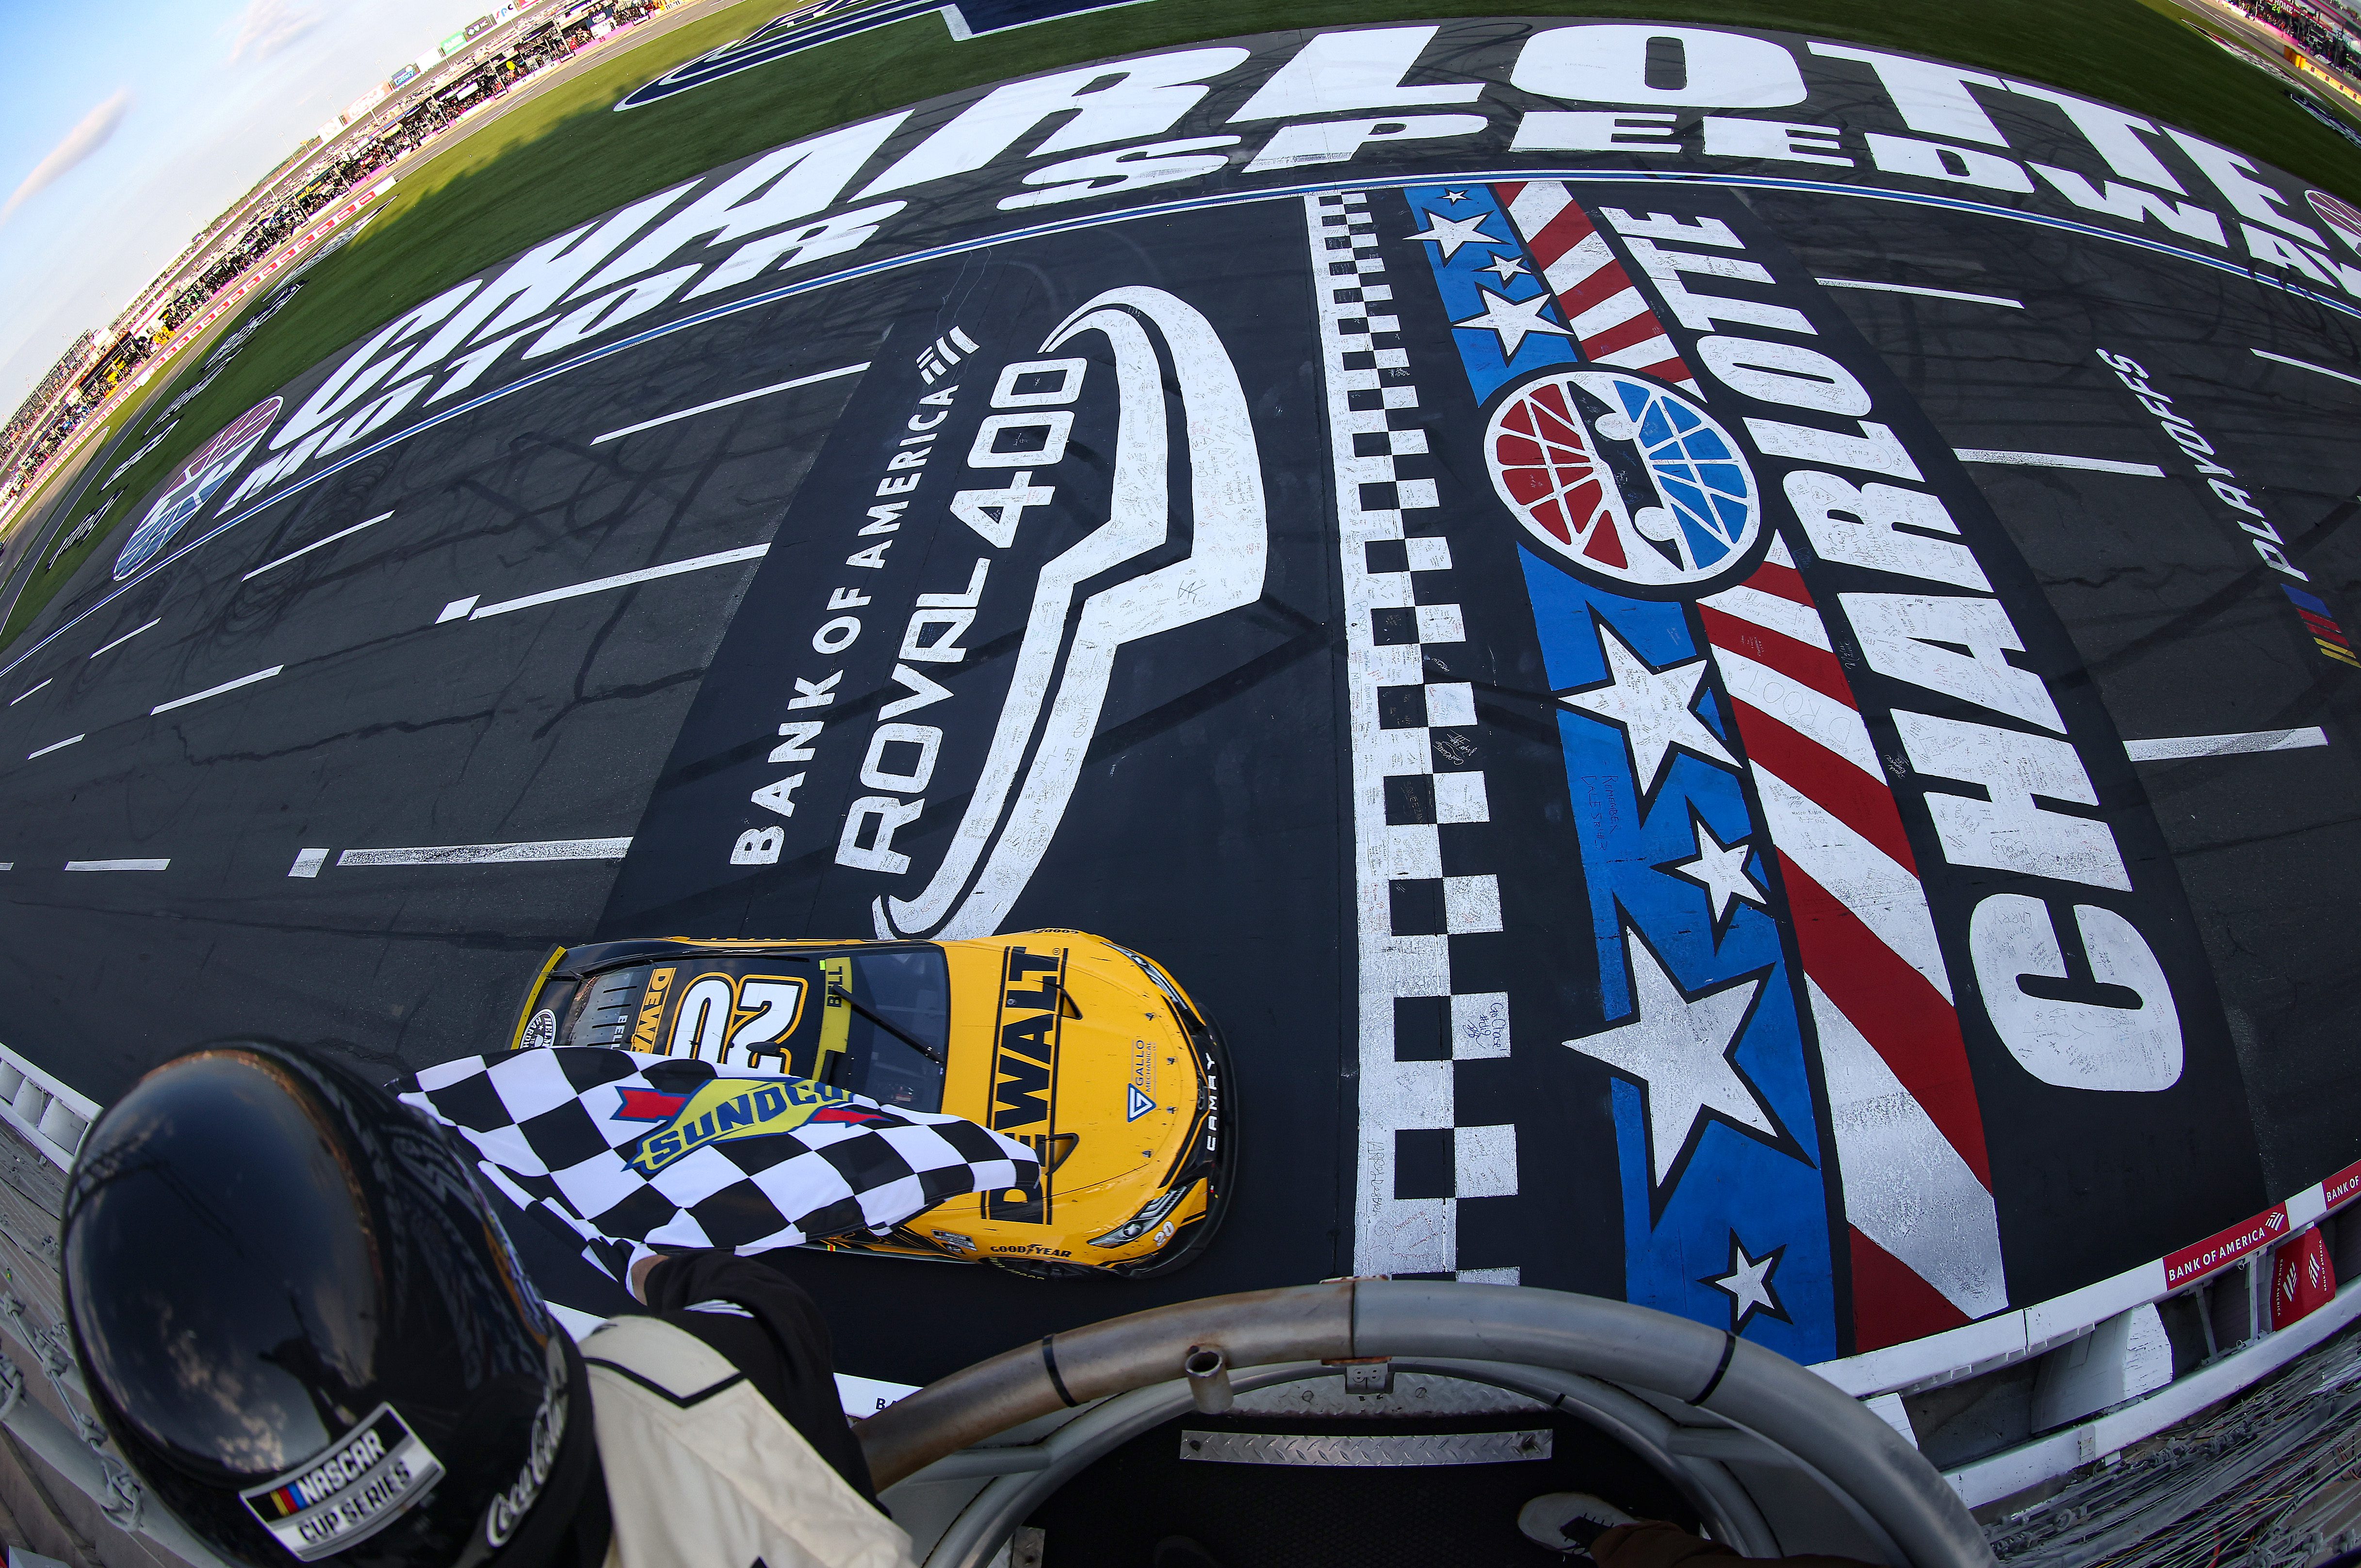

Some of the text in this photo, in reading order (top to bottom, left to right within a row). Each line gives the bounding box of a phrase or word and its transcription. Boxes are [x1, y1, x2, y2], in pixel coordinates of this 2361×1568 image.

[2272, 4, 2281, 14] 24
[395, 69, 415, 86] Lottery
[318, 224, 330, 235] TOYOTA
[339, 210, 351, 220] TOYOTA
[360, 193, 373, 205] TOYOTA
[270, 24, 2329, 450] CHARLOTTE
[281, 253, 292, 263] TOYOTA
[299, 238, 310, 248] TOYOTA
[213, 200, 908, 519] MOTOR
[101, 419, 180, 490] GEICO
[2096, 348, 2309, 582] PLAYOFFS
[730, 385, 959, 865] BANK OF AMERICA
[835, 358, 1088, 874] ROVAL 400
[1599, 206, 2184, 1093] CHARLOTTE
[1581, 776, 1601, 808] DALE
[1601, 775, 1621, 834] REMEMBER
[632, 967, 677, 1054] DEWA
[668, 975, 805, 1073] 20
[1490, 1003, 1500, 1018] Go
[648, 1081, 854, 1159] SUNOCO
[1206, 1052, 1218, 1151] CAMRY
[2326, 1175, 2359, 1203] BANK OF
[1154, 1221, 1175, 1248] 20
[2168, 1226, 2265, 1282] BANK OF AMERICA
[296, 1428, 387, 1505] NASCAR
[298, 1459, 412, 1545] CUP SERIES
